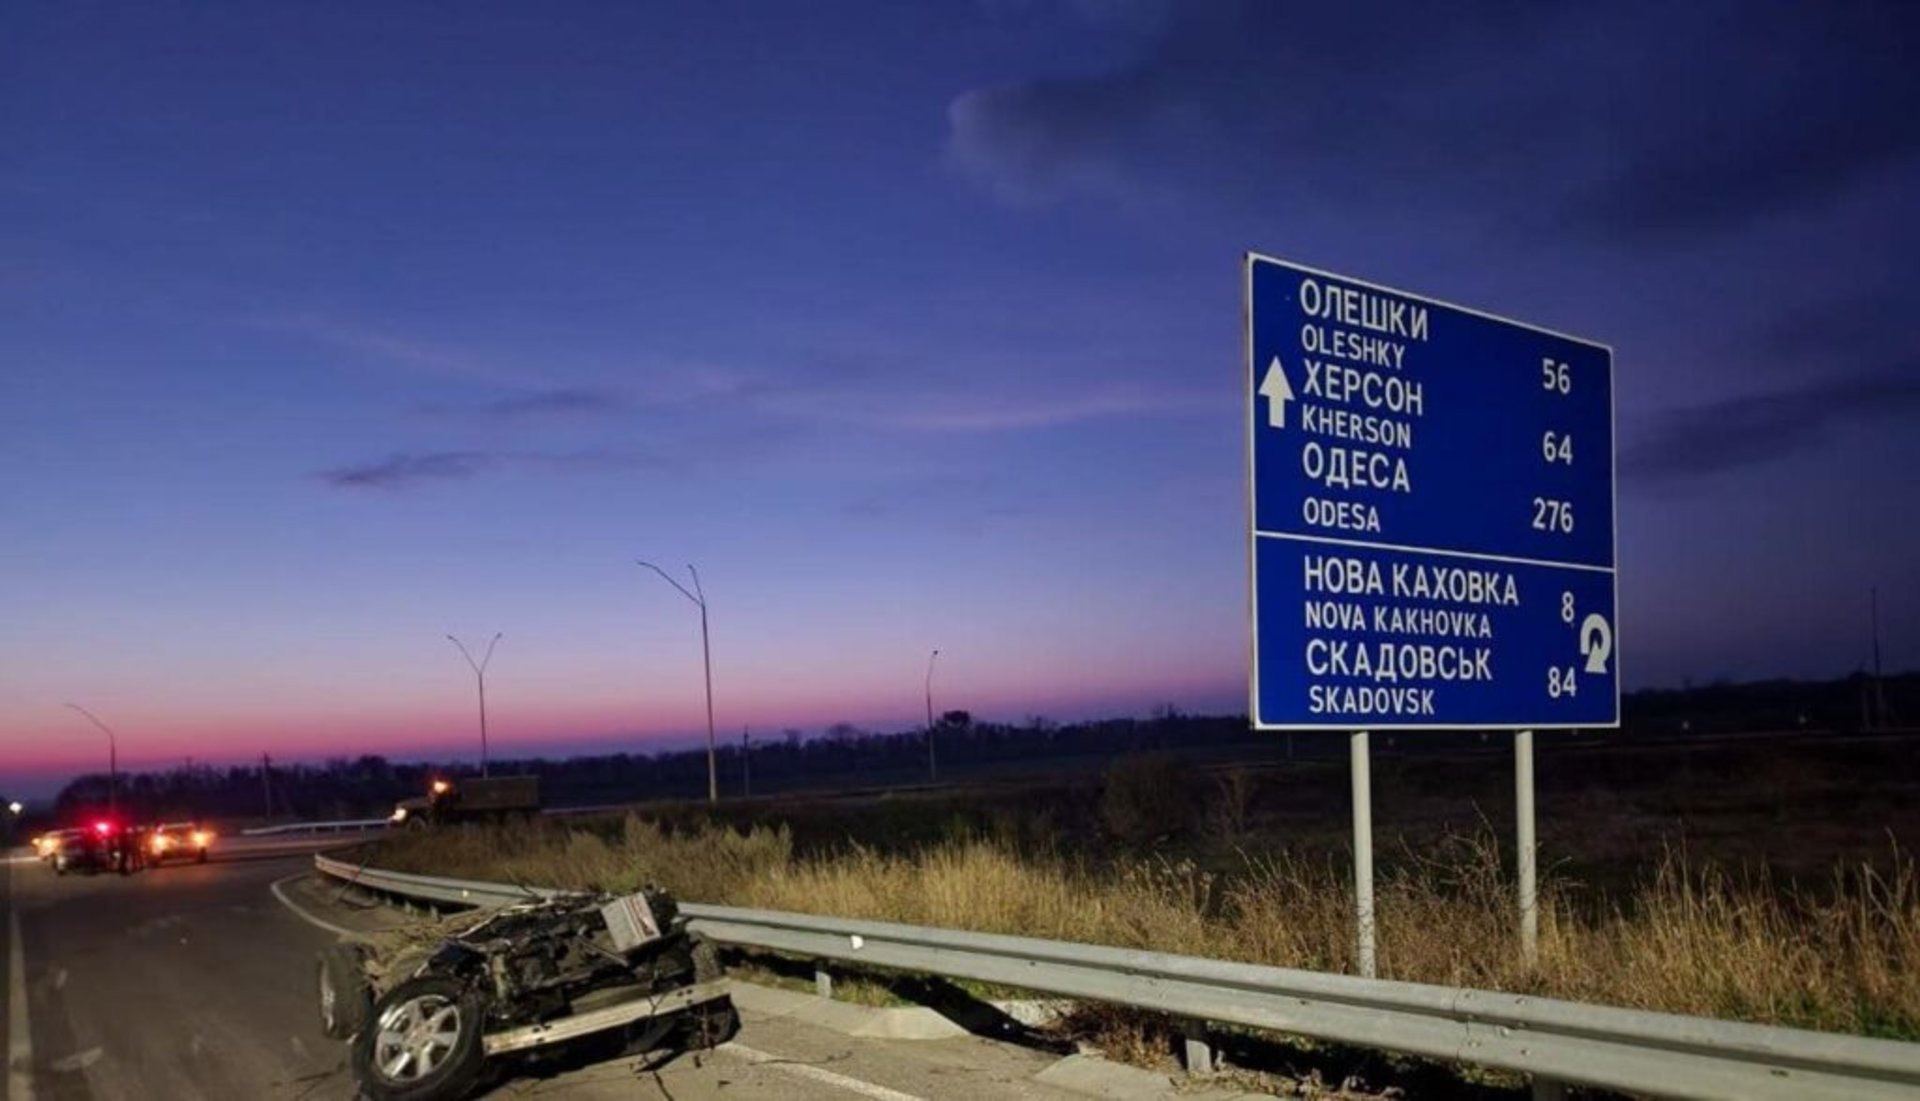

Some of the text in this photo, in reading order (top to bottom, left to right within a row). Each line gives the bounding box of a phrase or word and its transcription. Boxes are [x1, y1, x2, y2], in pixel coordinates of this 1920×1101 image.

[1300, 279, 1428, 341] ОЛЕШКИ
[1302, 324, 1405, 369] OLESHKY
[1303, 359, 1423, 415] ХЕРСОН
[1543, 359, 1570, 393] 56
[1302, 404, 1411, 448] KHERSON
[1303, 442, 1411, 492] ОДЕСА
[1543, 432, 1573, 465] 64
[1303, 497, 1381, 532] ODESA
[1532, 498, 1574, 532] 276
[1304, 555, 1519, 606] НОВА КАХОВКА
[1305, 600, 1492, 638] NOVA KAKHOVKA
[1562, 591, 1575, 622] 8
[1306, 638, 1493, 683] СКАДОВСЬК
[1308, 685, 1435, 715] SKADOVSK
[1548, 666, 1577, 698] 84
